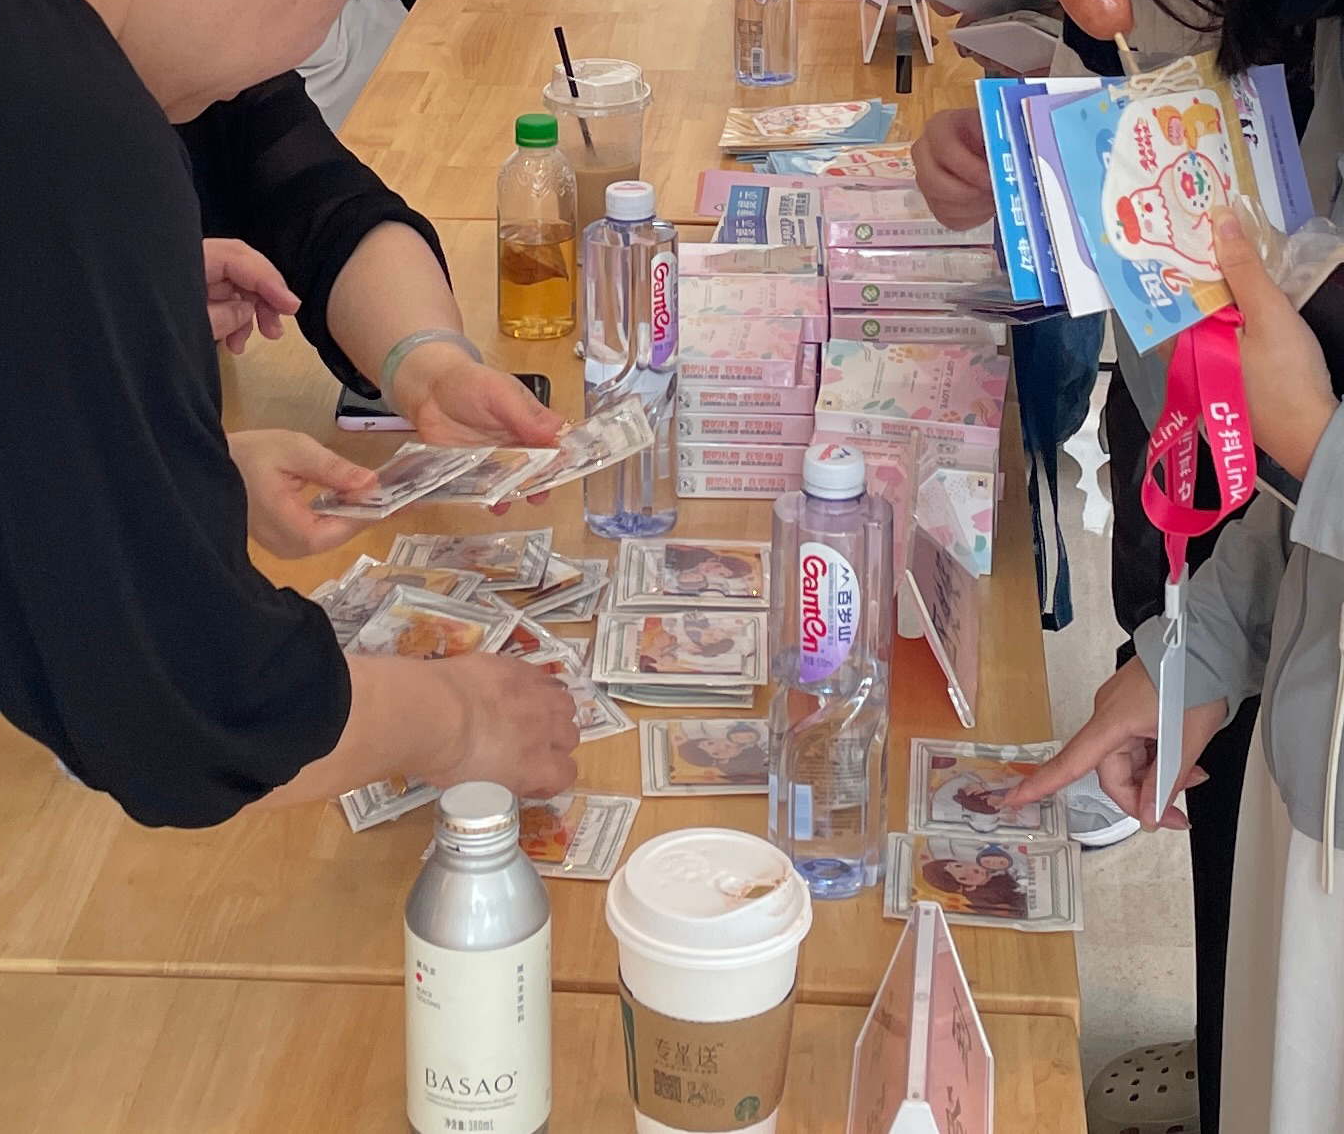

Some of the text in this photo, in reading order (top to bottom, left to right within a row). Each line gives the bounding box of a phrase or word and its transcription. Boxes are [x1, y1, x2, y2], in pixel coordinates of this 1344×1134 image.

[837, 590, 852, 644] 百岁山
[425, 1067, 515, 1097] BASAO
